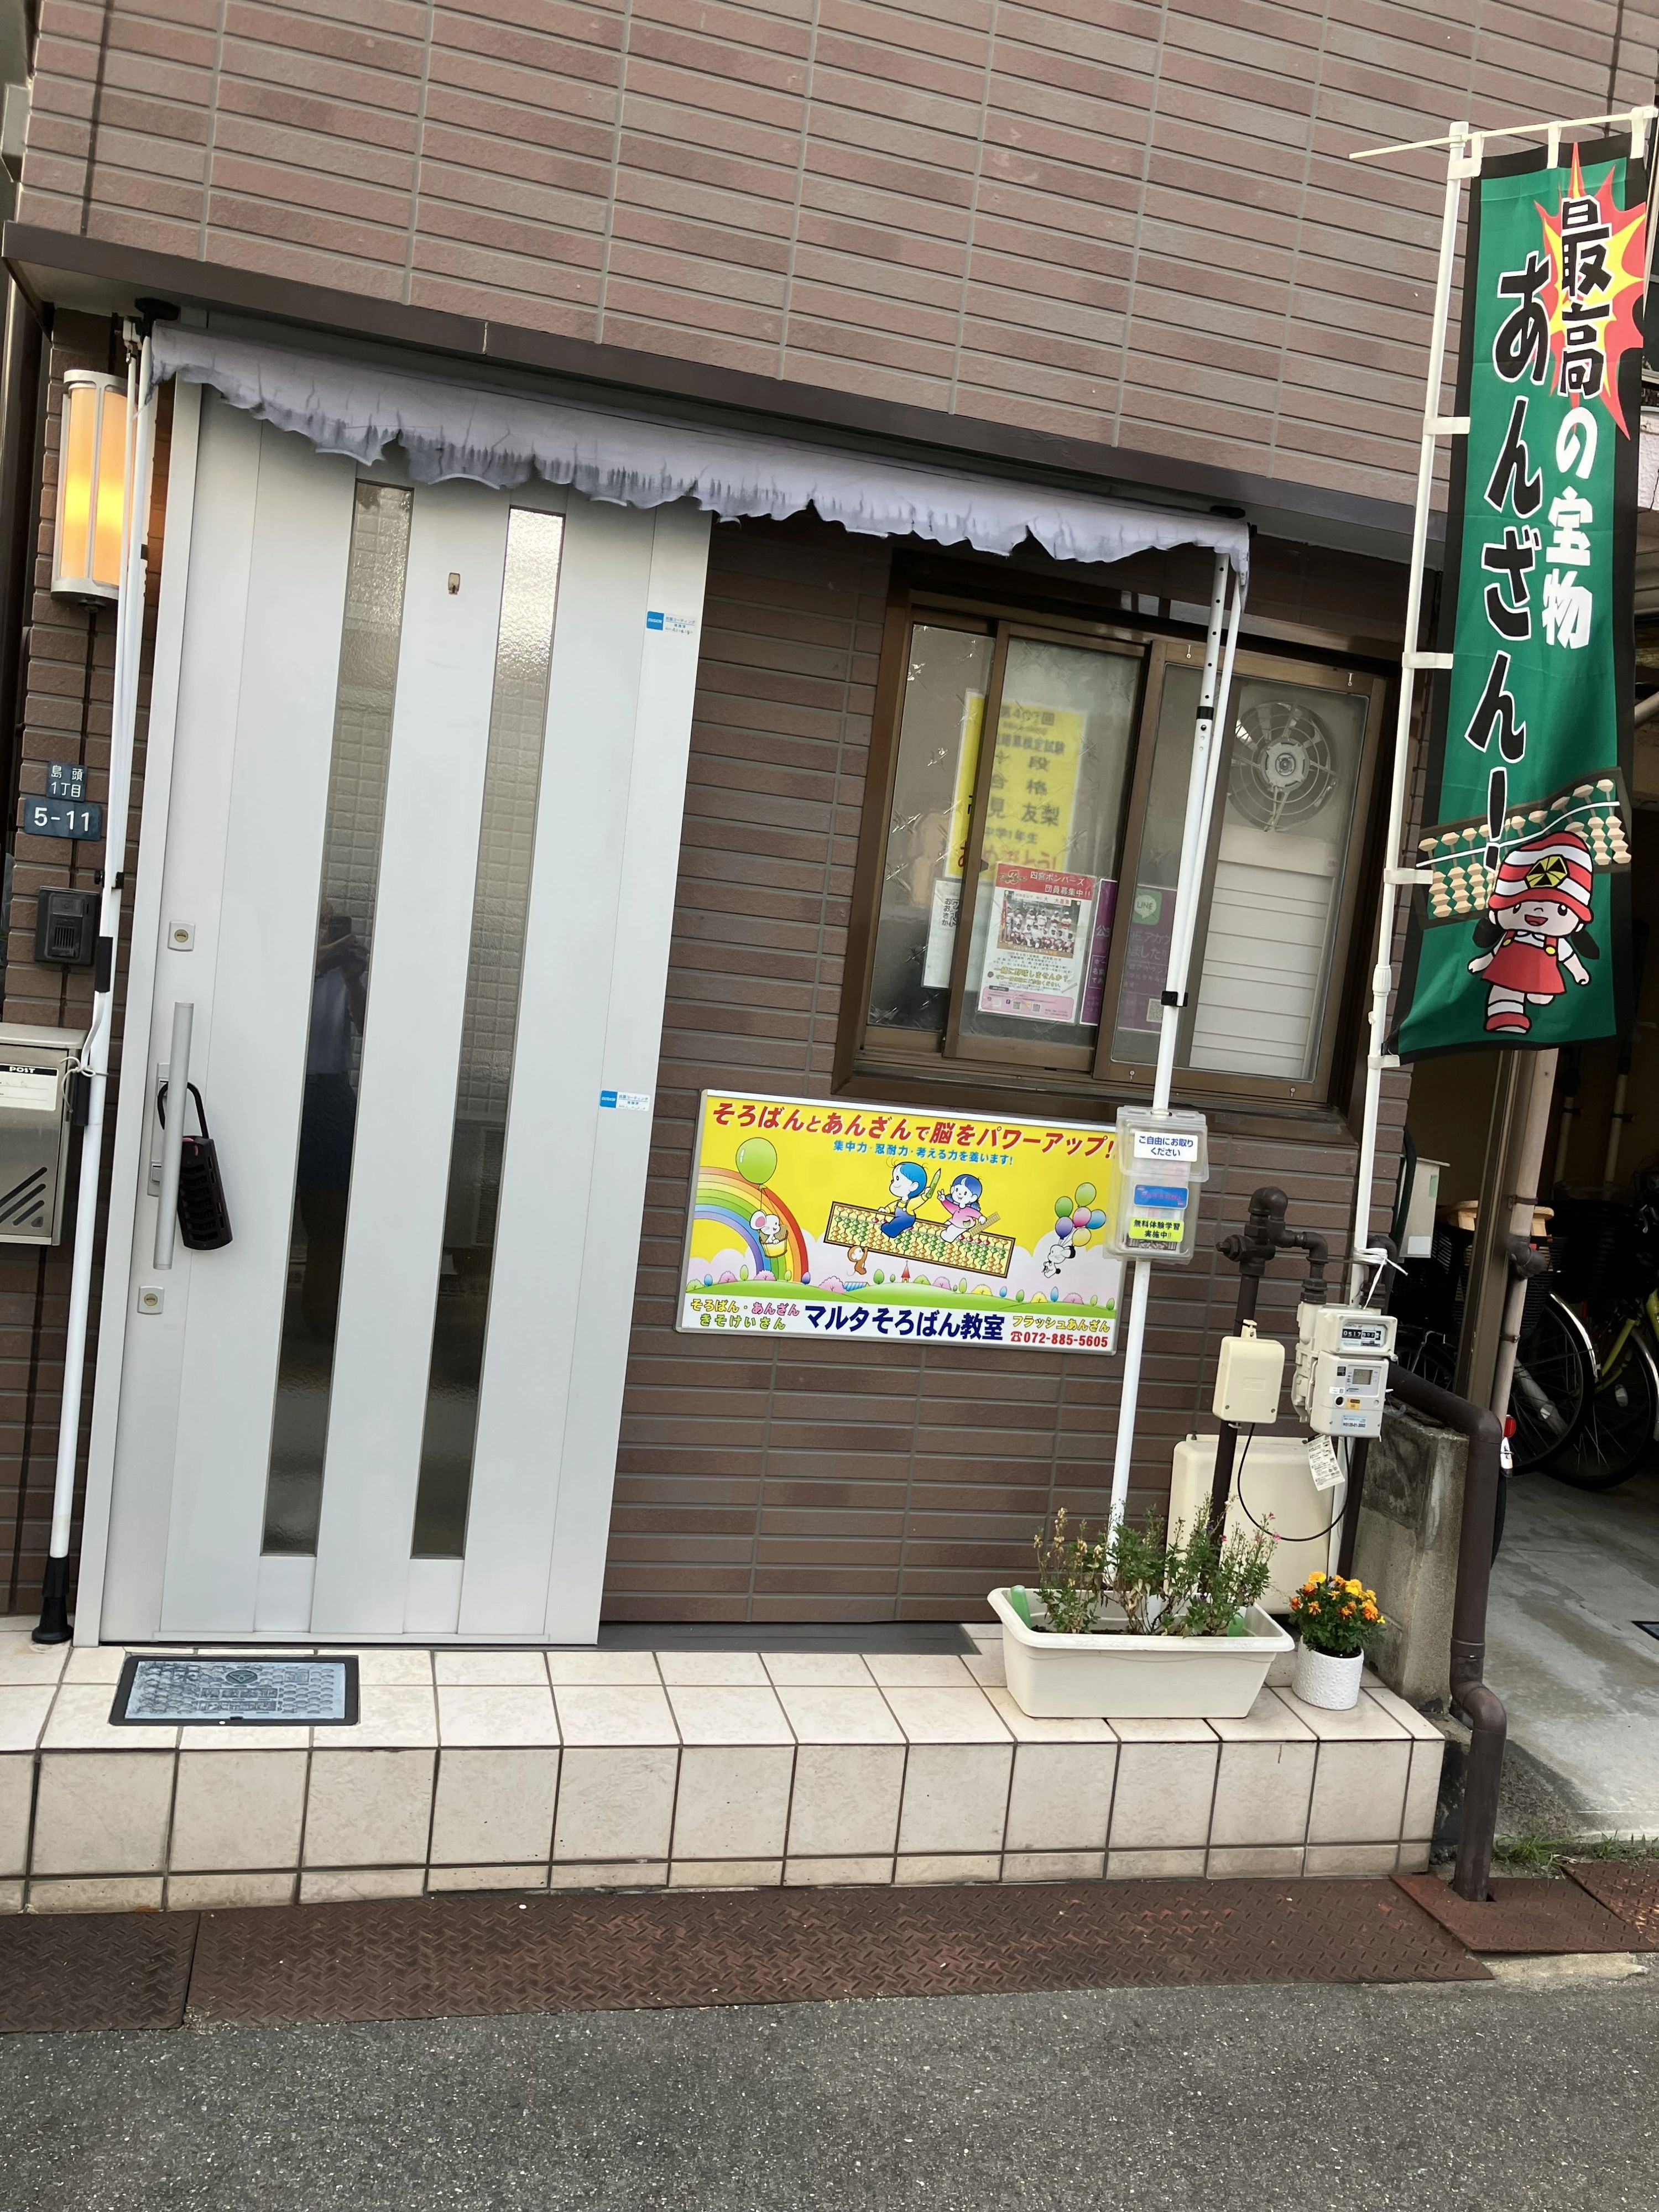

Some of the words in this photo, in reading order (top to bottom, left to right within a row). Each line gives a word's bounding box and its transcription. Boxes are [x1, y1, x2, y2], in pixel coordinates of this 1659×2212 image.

[1542, 195, 1613, 649] 最高の宝物
[51, 765, 84, 781] 島頭
[51, 782, 81, 797] 1丁目
[34, 807, 90, 831] 5-11
[1137, 901, 1153, 910] LINE
[713, 1102, 1116, 1159] そろばんとあんざんで脳をパワーアップ!
[1139, 1136, 1194, 1147] ご自由にお取り
[1150, 1147, 1181, 1157] ください
[1133, 1219, 1180, 1231] 無料体験学習
[700, 1314, 786, 1330] きそけいさん
[805, 1305, 1005, 1340] マルタそろばん教室
[1013, 1315, 1110, 1333] フラッシュあんざん
[1023, 1332, 1109, 1348] 072-885-5605
